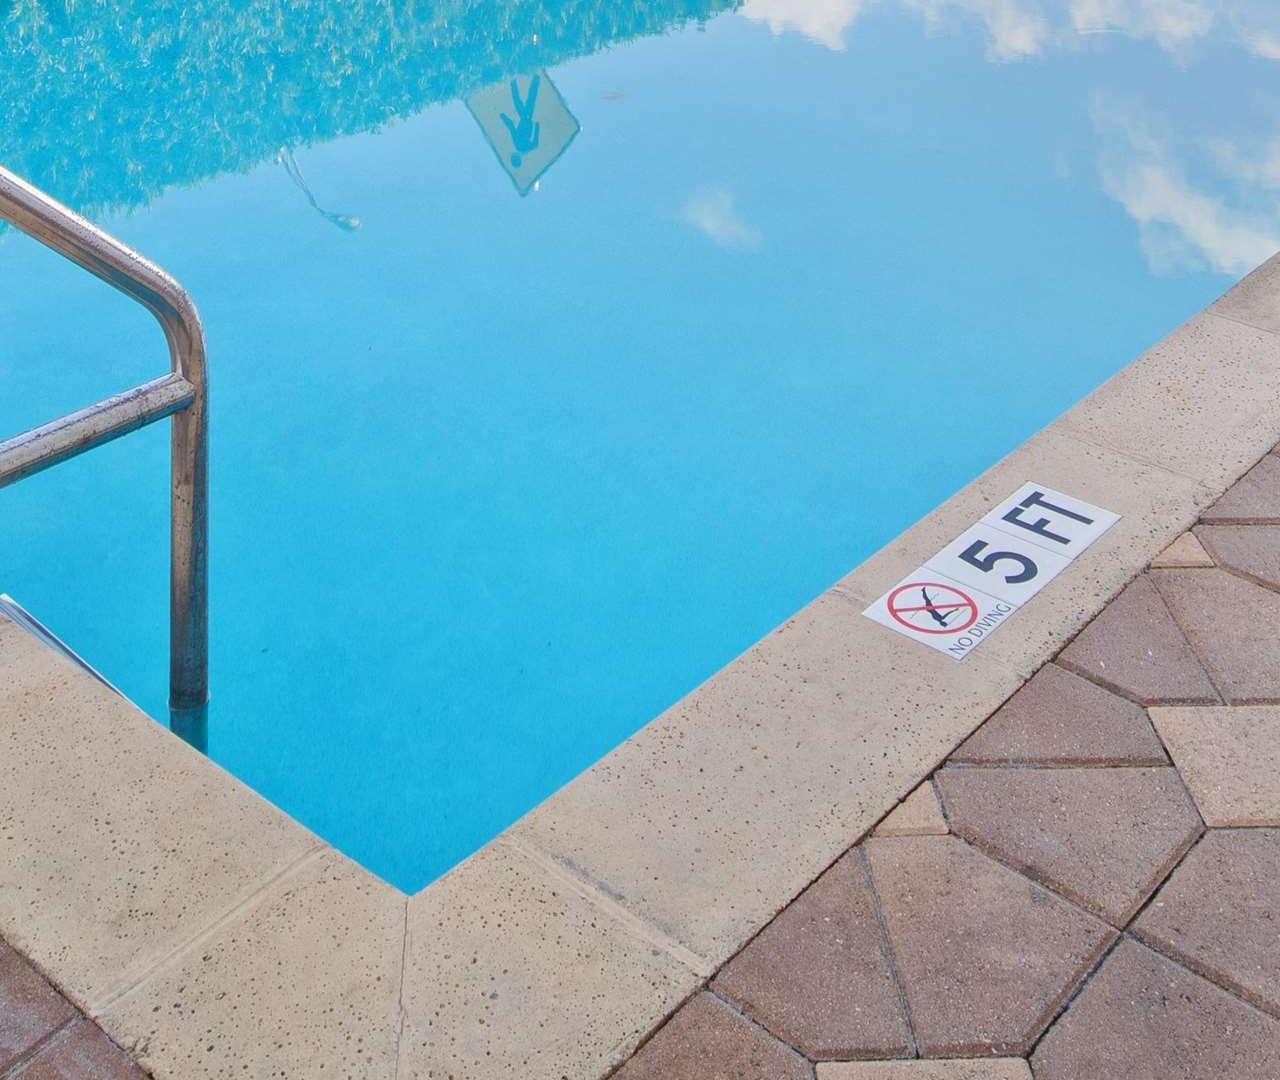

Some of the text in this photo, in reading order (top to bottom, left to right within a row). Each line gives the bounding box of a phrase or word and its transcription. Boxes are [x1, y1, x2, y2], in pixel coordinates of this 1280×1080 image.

[958, 490, 1095, 585] 5 FT
[949, 602, 1013, 655] NO DIVING
